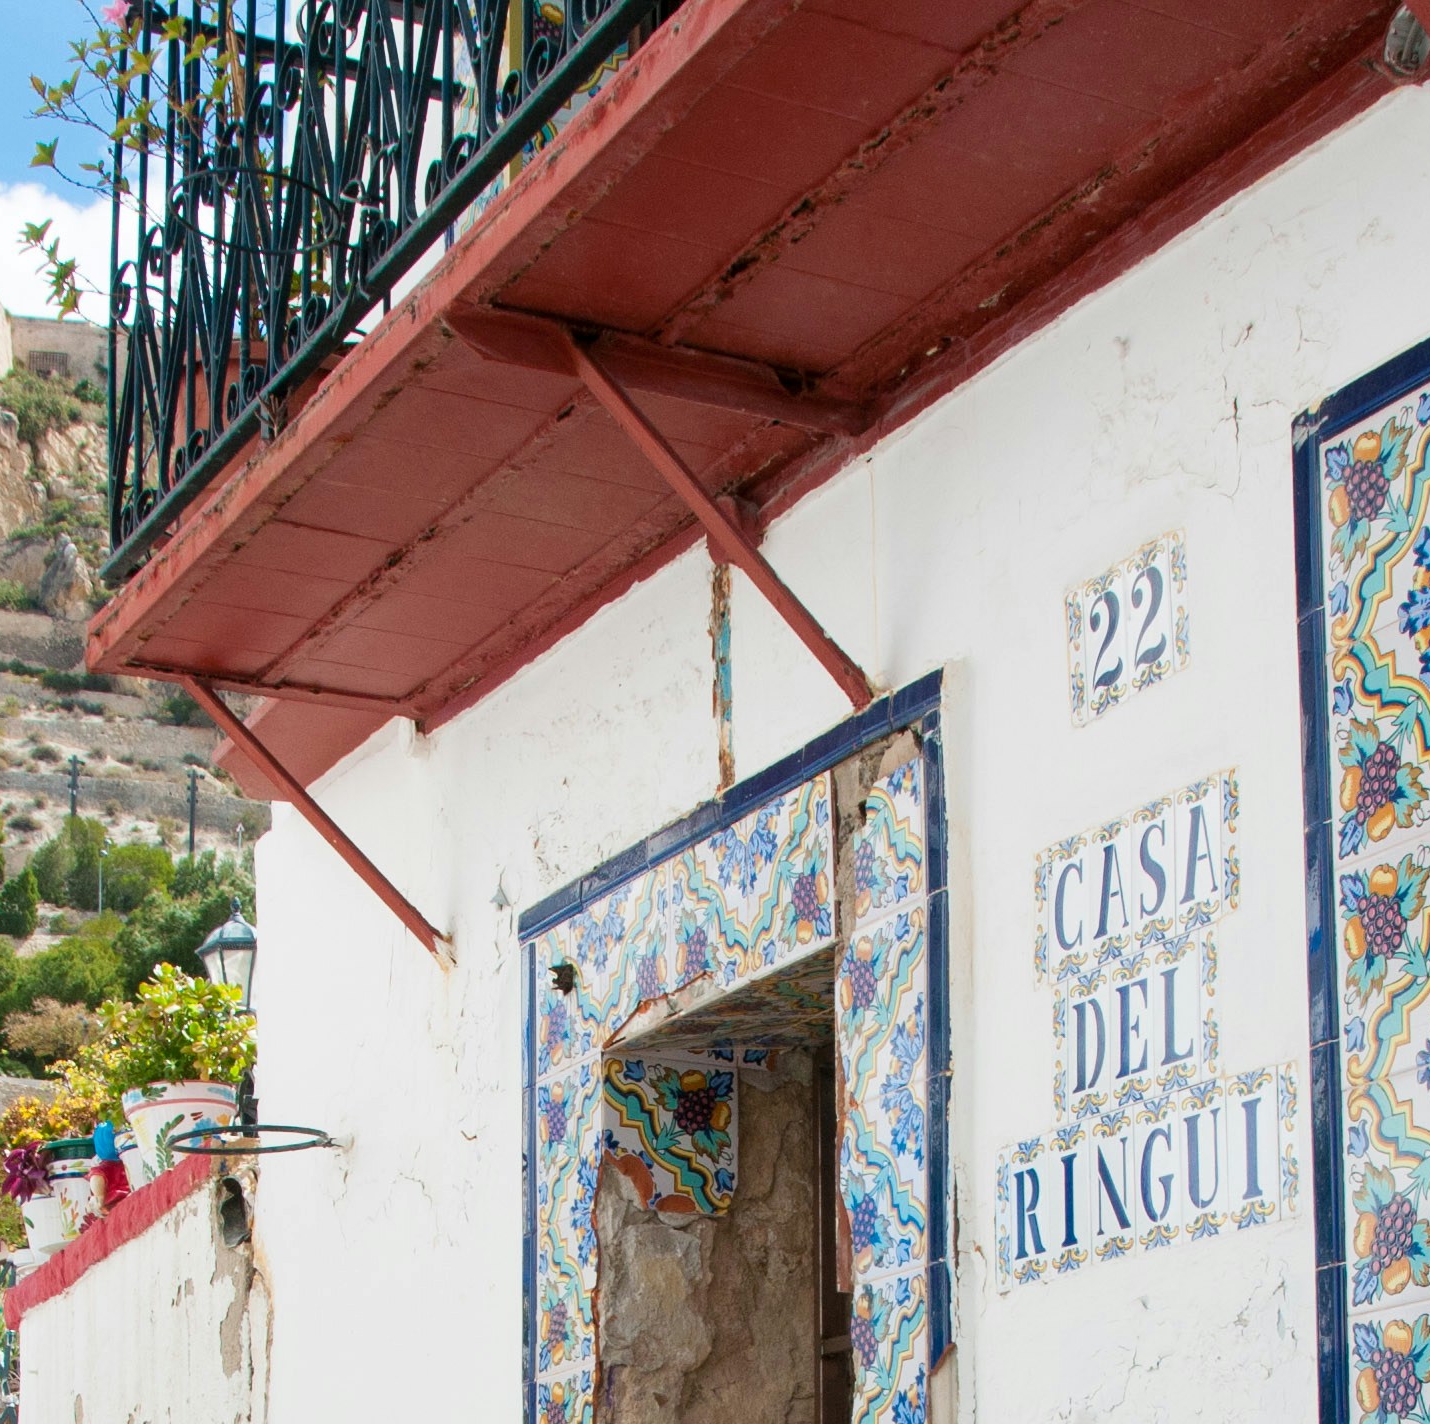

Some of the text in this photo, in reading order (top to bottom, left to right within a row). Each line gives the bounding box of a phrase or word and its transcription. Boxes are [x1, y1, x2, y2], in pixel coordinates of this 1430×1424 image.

[1089, 566, 1168, 693] 22
[1054, 804, 1219, 952] CASA
[1072, 967, 1195, 1095] DEL
[1013, 1096, 1264, 1261] RINGUI
